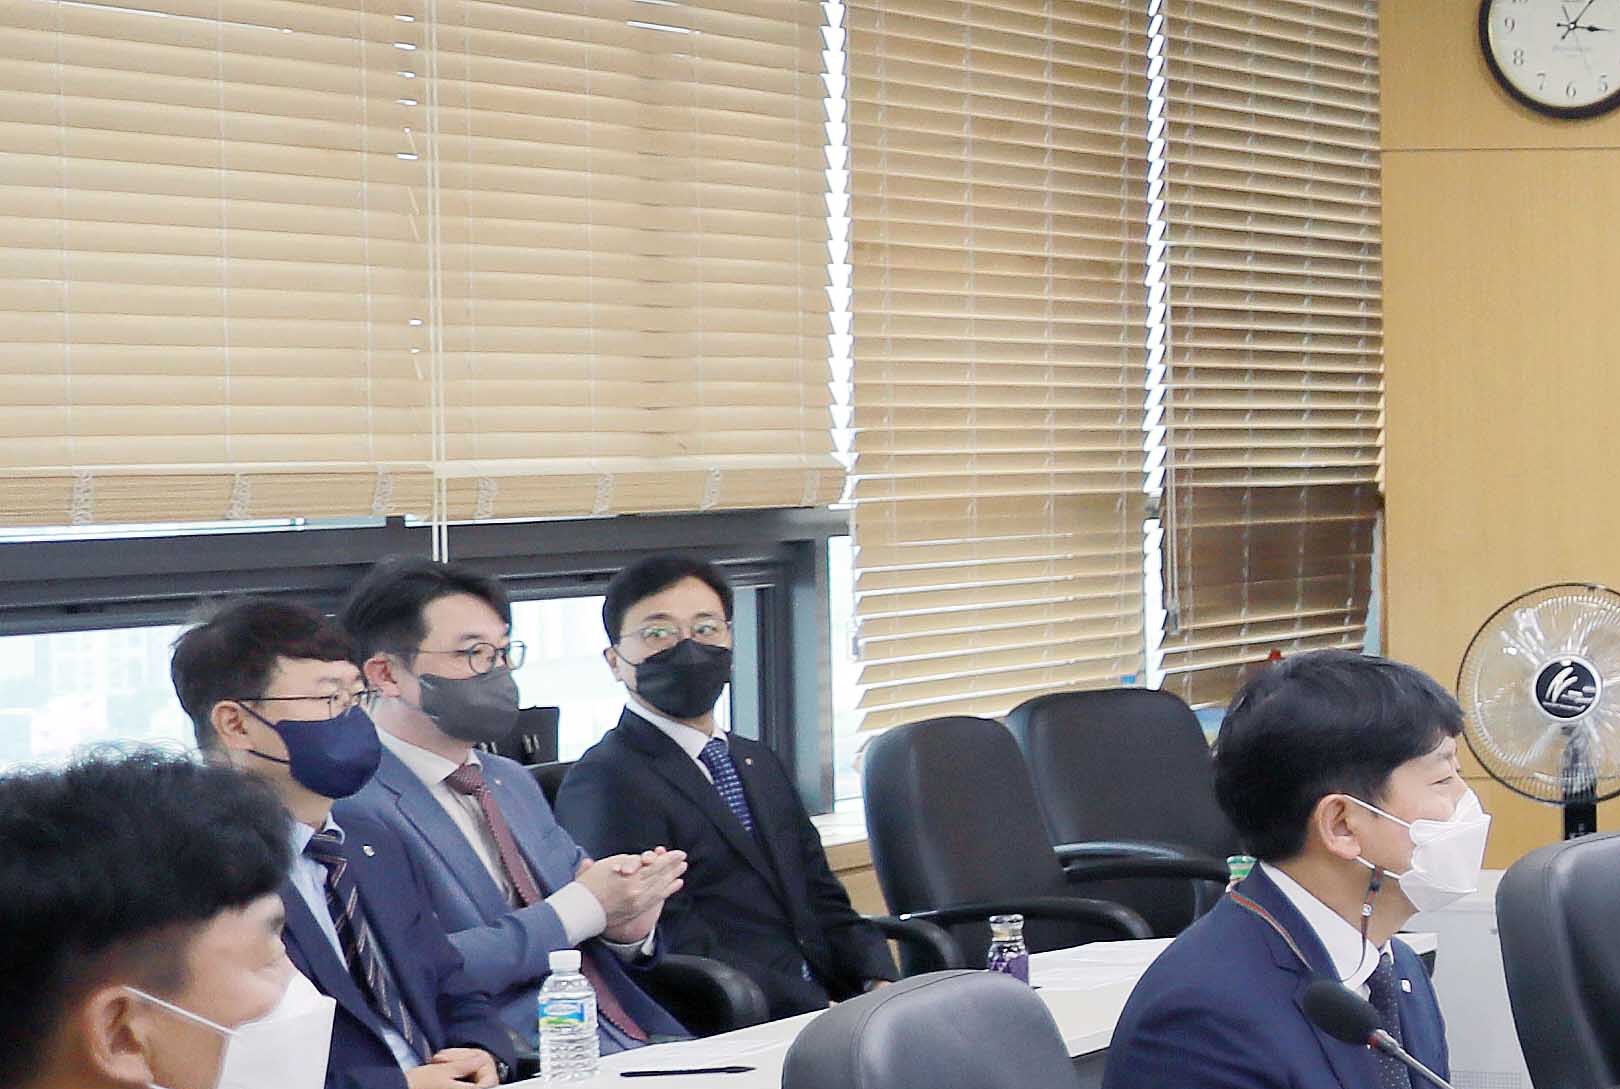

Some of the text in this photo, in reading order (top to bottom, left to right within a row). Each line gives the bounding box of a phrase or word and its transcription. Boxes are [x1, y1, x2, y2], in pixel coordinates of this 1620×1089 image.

[1504, 16, 1516, 33] 9
[1512, 47, 1525, 66] 8
[1536, 72, 1547, 92] 7
[1565, 81, 1577, 99] 6
[1598, 74, 1609, 93] 5
